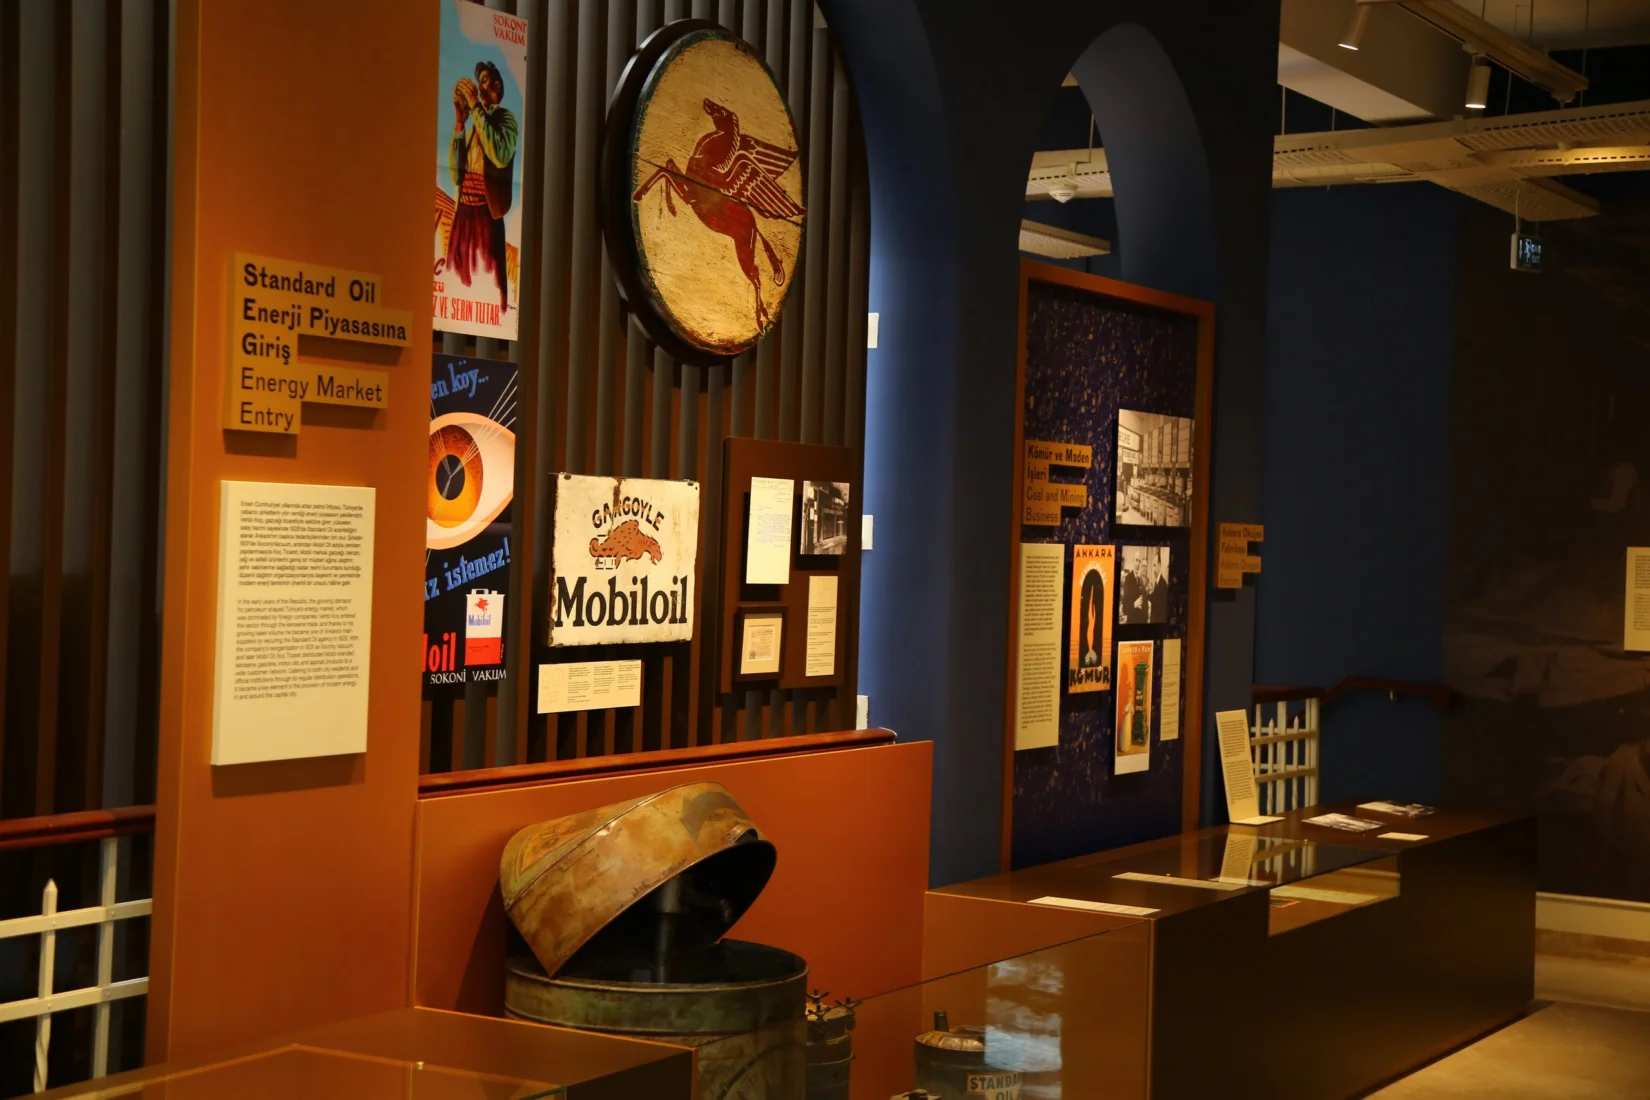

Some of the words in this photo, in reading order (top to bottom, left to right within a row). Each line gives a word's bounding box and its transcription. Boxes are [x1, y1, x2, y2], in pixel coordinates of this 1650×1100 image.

[493, 25, 525, 46] VAKUM
[243, 263, 336, 298] Standard
[349, 279, 375, 304] Oil
[243, 298, 302, 330] Enerji
[309, 306, 407, 340] Piyasasına
[440, 296, 448, 319] VE
[475, 302, 502, 326] TUTAR.
[242, 332, 291, 365] Giriş
[241, 367, 309, 399] Energy
[317, 374, 382, 402] Market
[240, 402, 294, 432] Entry
[1028, 444, 1052, 460] Kömür
[1055, 452, 1064, 462] ve
[1066, 448, 1090, 464] Maden
[1026, 486, 1044, 501] Coal
[1046, 488, 1058, 502] and
[1060, 488, 1084, 506] Mining
[592, 496, 664, 532] GARGOYLE
[1026, 507, 1058, 522] Business
[443, 536, 511, 592] istemez!
[1076, 548, 1112, 558] ANKARA
[554, 575, 688, 628] Mobiloil
[468, 614, 492, 626] Mobiloil
[430, 668, 466, 684] SOKONİ
[472, 669, 507, 682] VAKUM
[1069, 666, 1110, 687] KÖMÜR
